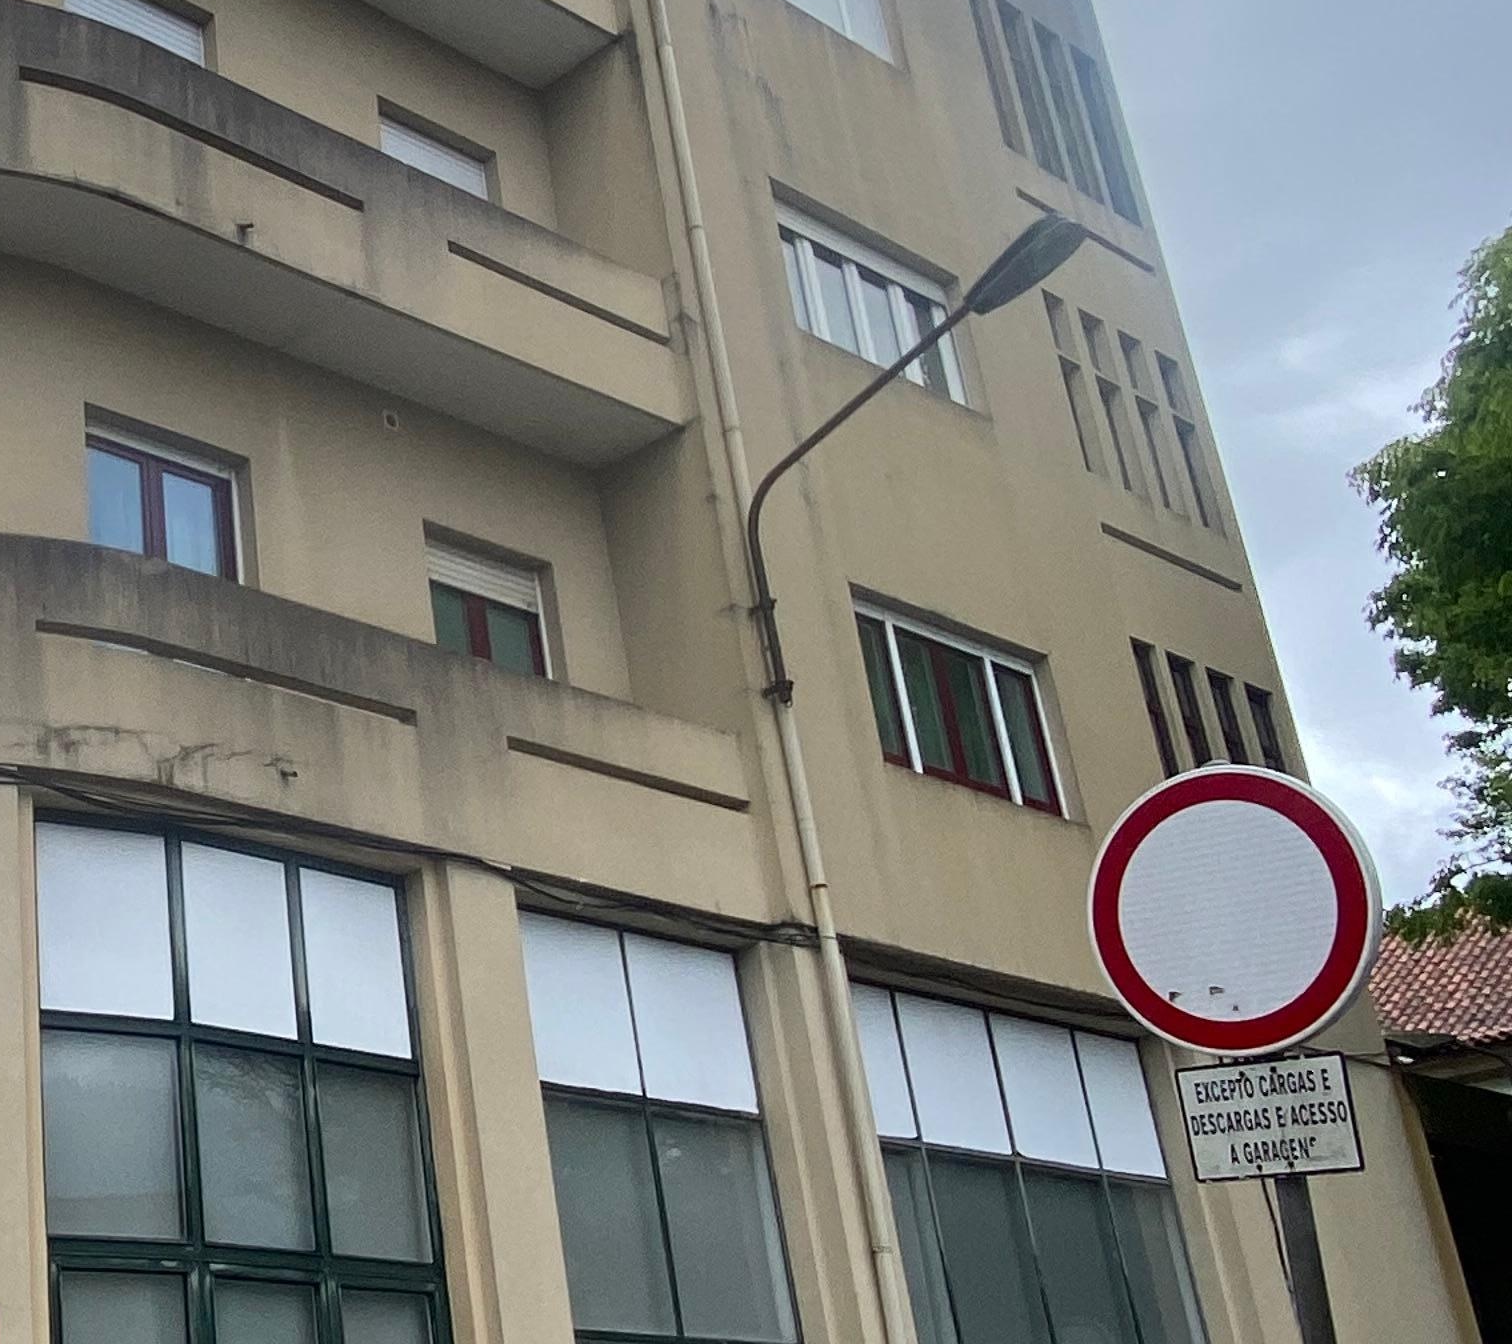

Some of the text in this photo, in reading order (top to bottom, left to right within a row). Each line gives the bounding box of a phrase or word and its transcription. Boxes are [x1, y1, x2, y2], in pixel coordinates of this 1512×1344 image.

[1194, 1068, 1332, 1104] EXCEPTO CARGAS E
[1190, 1101, 1348, 1137] DESCARGAS E ACESSO
[1230, 1143, 1240, 1165] A
